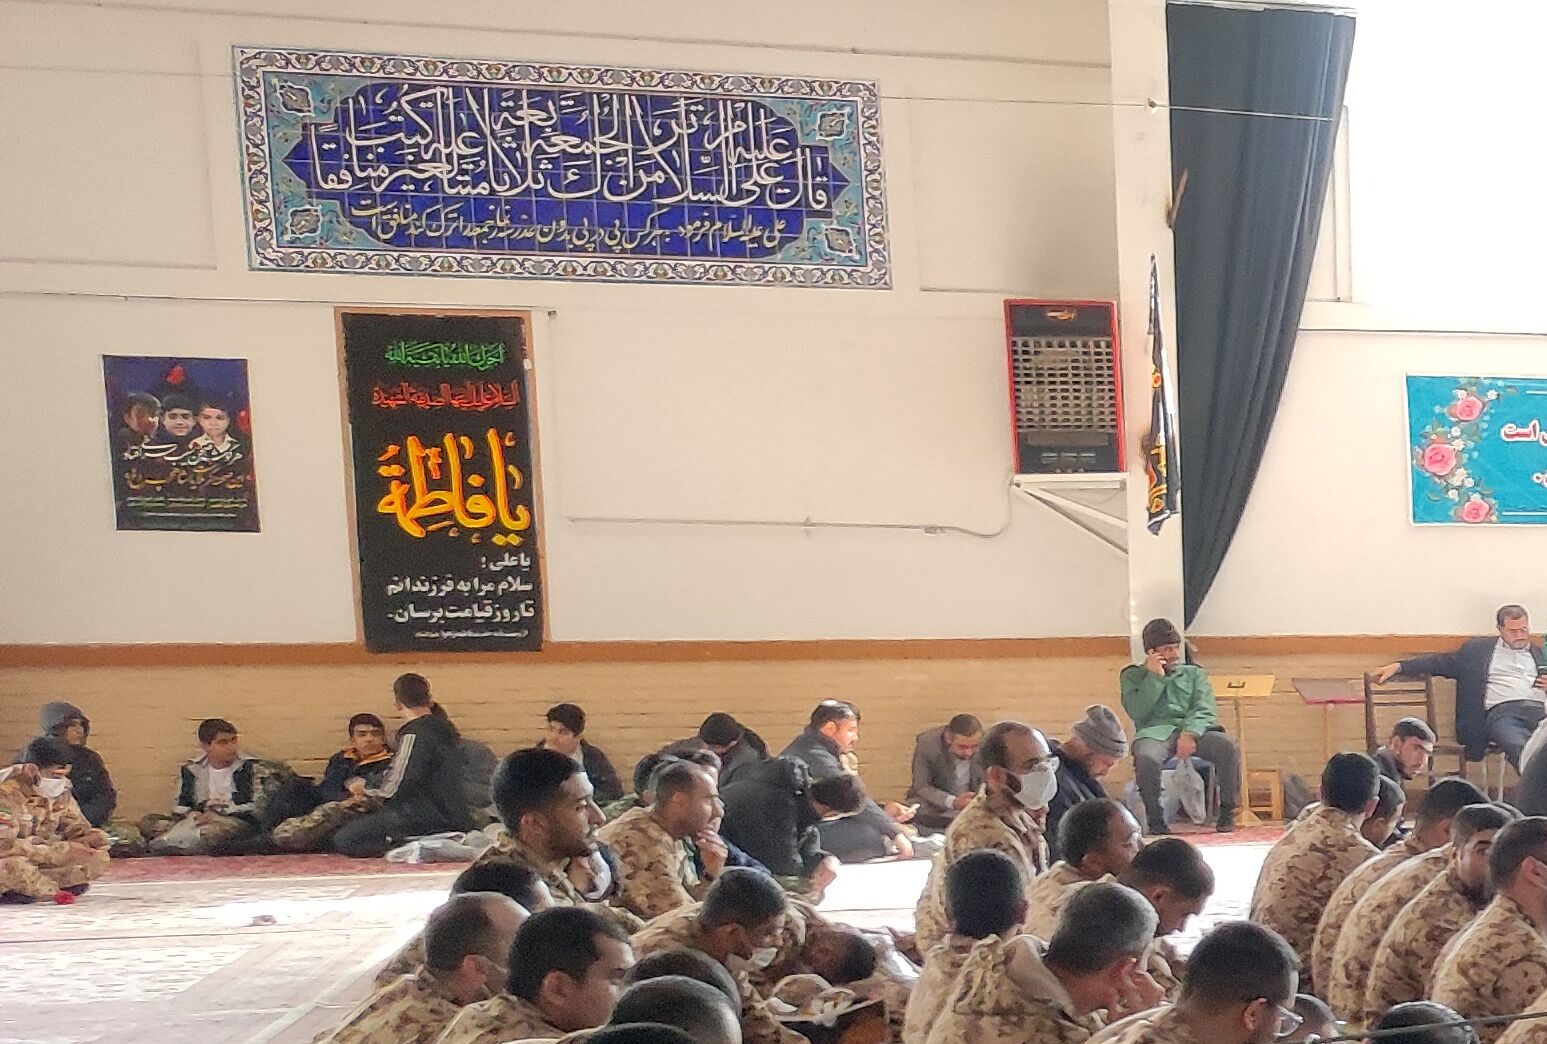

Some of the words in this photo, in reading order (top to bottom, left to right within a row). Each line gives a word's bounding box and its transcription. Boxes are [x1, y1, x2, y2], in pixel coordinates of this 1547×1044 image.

[1501, 419, 1540, 441] است
[457, 579, 472, 597] به
[473, 576, 496, 596] مرا
[498, 575, 533, 596] سلام
[445, 600, 494, 623] قیامت
[491, 603, 520, 622] روز
[520, 600, 535, 617] تا
